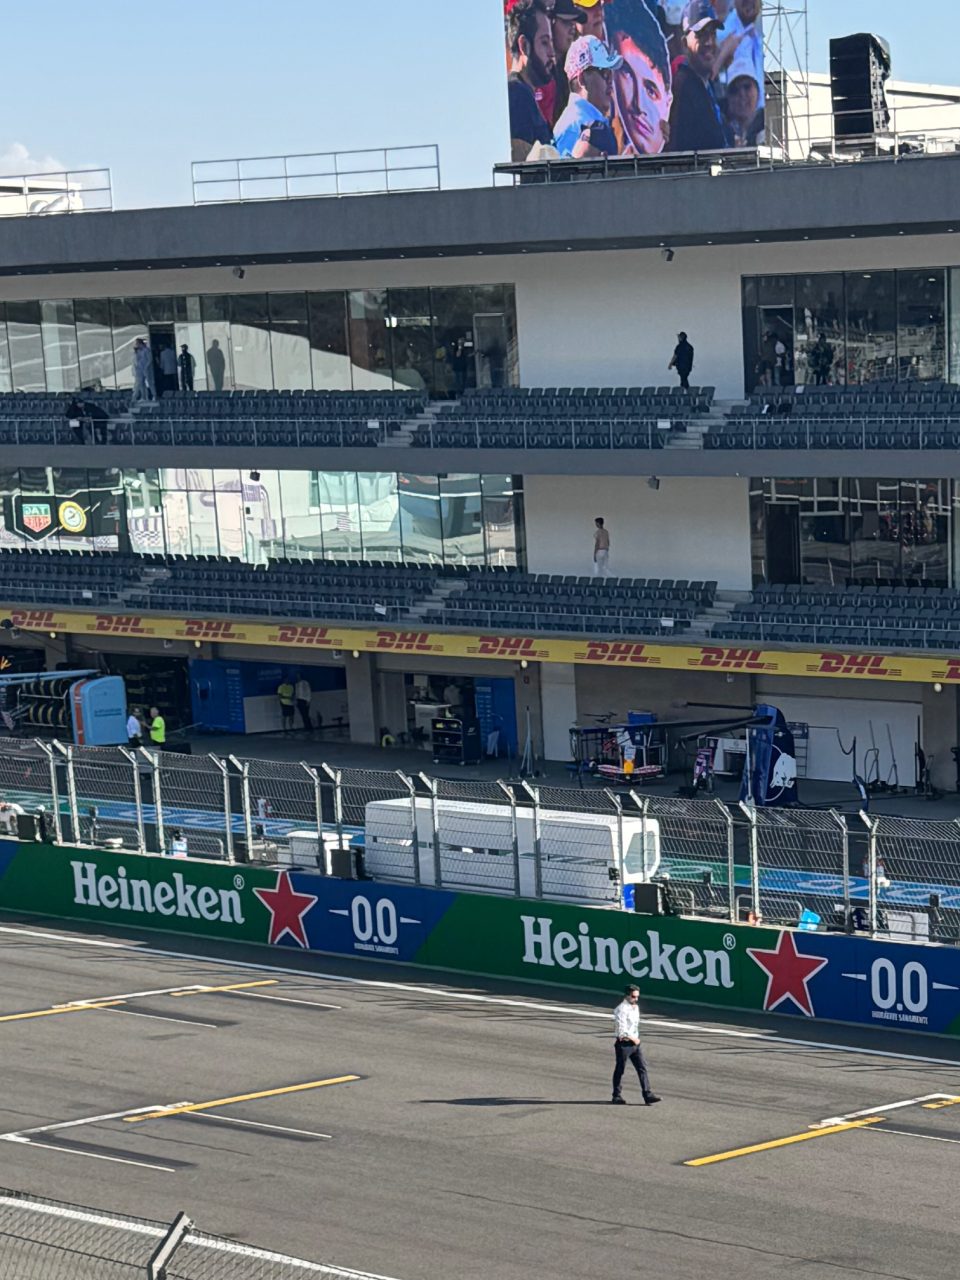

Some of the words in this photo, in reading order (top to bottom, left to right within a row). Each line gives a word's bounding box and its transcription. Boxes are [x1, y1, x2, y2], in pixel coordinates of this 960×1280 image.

[11, 611, 60, 628] DHL
[96, 615, 147, 633] DHL
[185, 620, 239, 639] DHL
[278, 625, 333, 645] DHL
[376, 631, 433, 651] DHL
[478, 636, 540, 657] DHL
[586, 642, 650, 663] DHL
[700, 647, 768, 670] DHL
[819, 653, 889, 676] DHL
